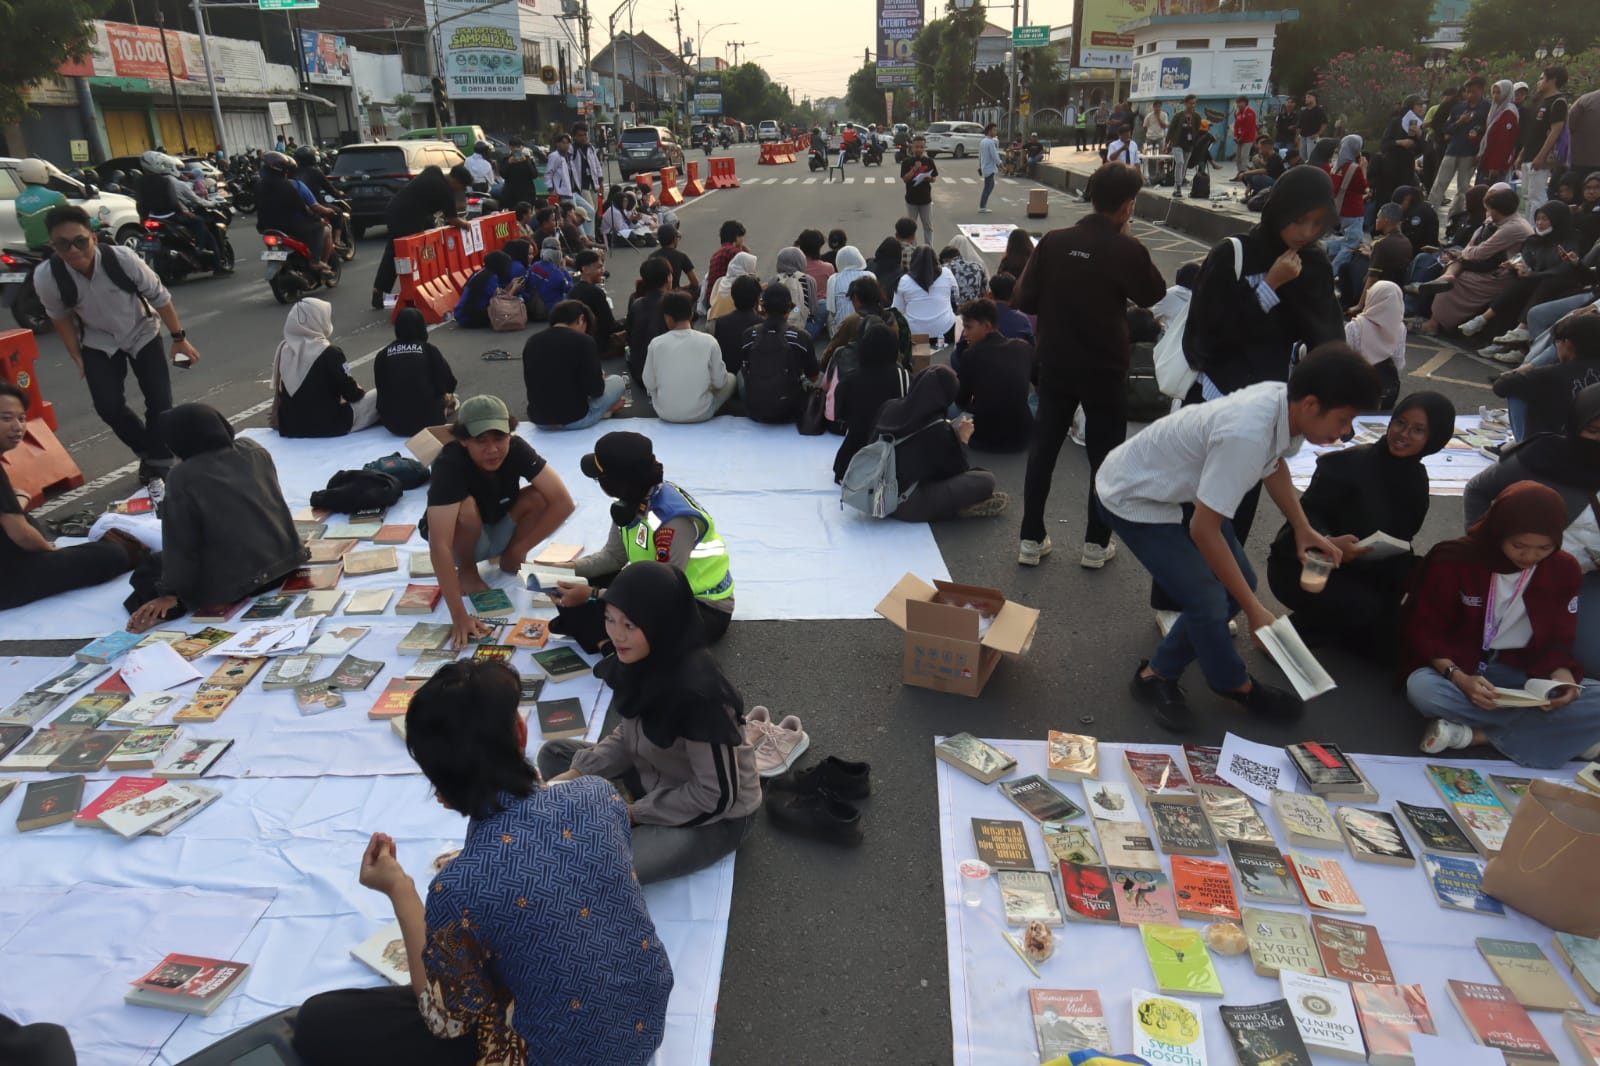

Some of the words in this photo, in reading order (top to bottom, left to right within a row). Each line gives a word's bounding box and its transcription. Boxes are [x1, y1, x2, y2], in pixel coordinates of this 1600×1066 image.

[113, 38, 165, 63] 10.000
[1010, 782, 1041, 794] GIBRAN
[1238, 857, 1283, 869] edensor
[1255, 941, 1310, 957] DEBAT
[1263, 952, 1308, 967] ILMU
[1064, 1002, 1093, 1014] Muda
[1232, 1013, 1269, 1023] POWER
[1149, 1037, 1191, 1055] TERAS
[1140, 1046, 1202, 1066] FILOSOFI
